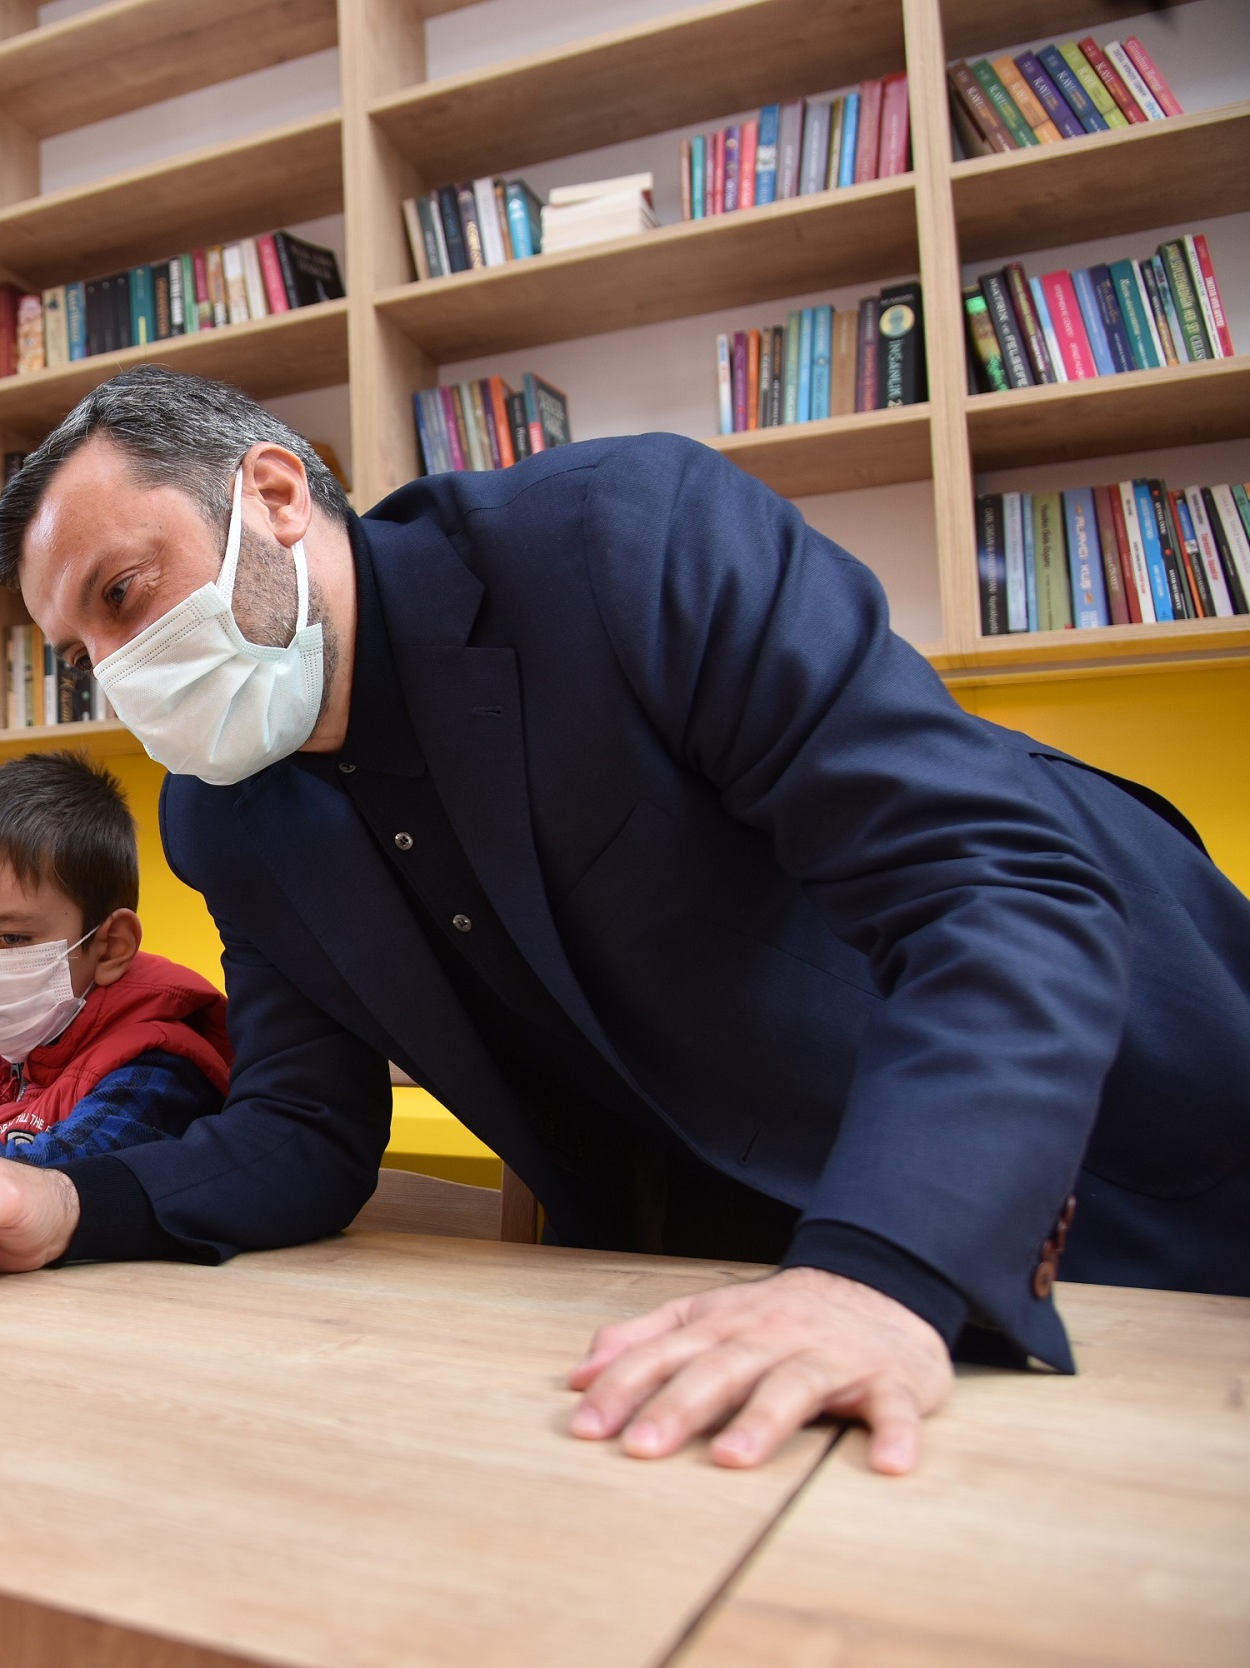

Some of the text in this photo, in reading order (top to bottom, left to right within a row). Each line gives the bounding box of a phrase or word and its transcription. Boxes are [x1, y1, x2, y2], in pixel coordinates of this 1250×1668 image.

[988, 277, 1008, 322] MATRIX
[1078, 563, 1091, 590] KUŞ
[30, 1113, 45, 1131] THE
